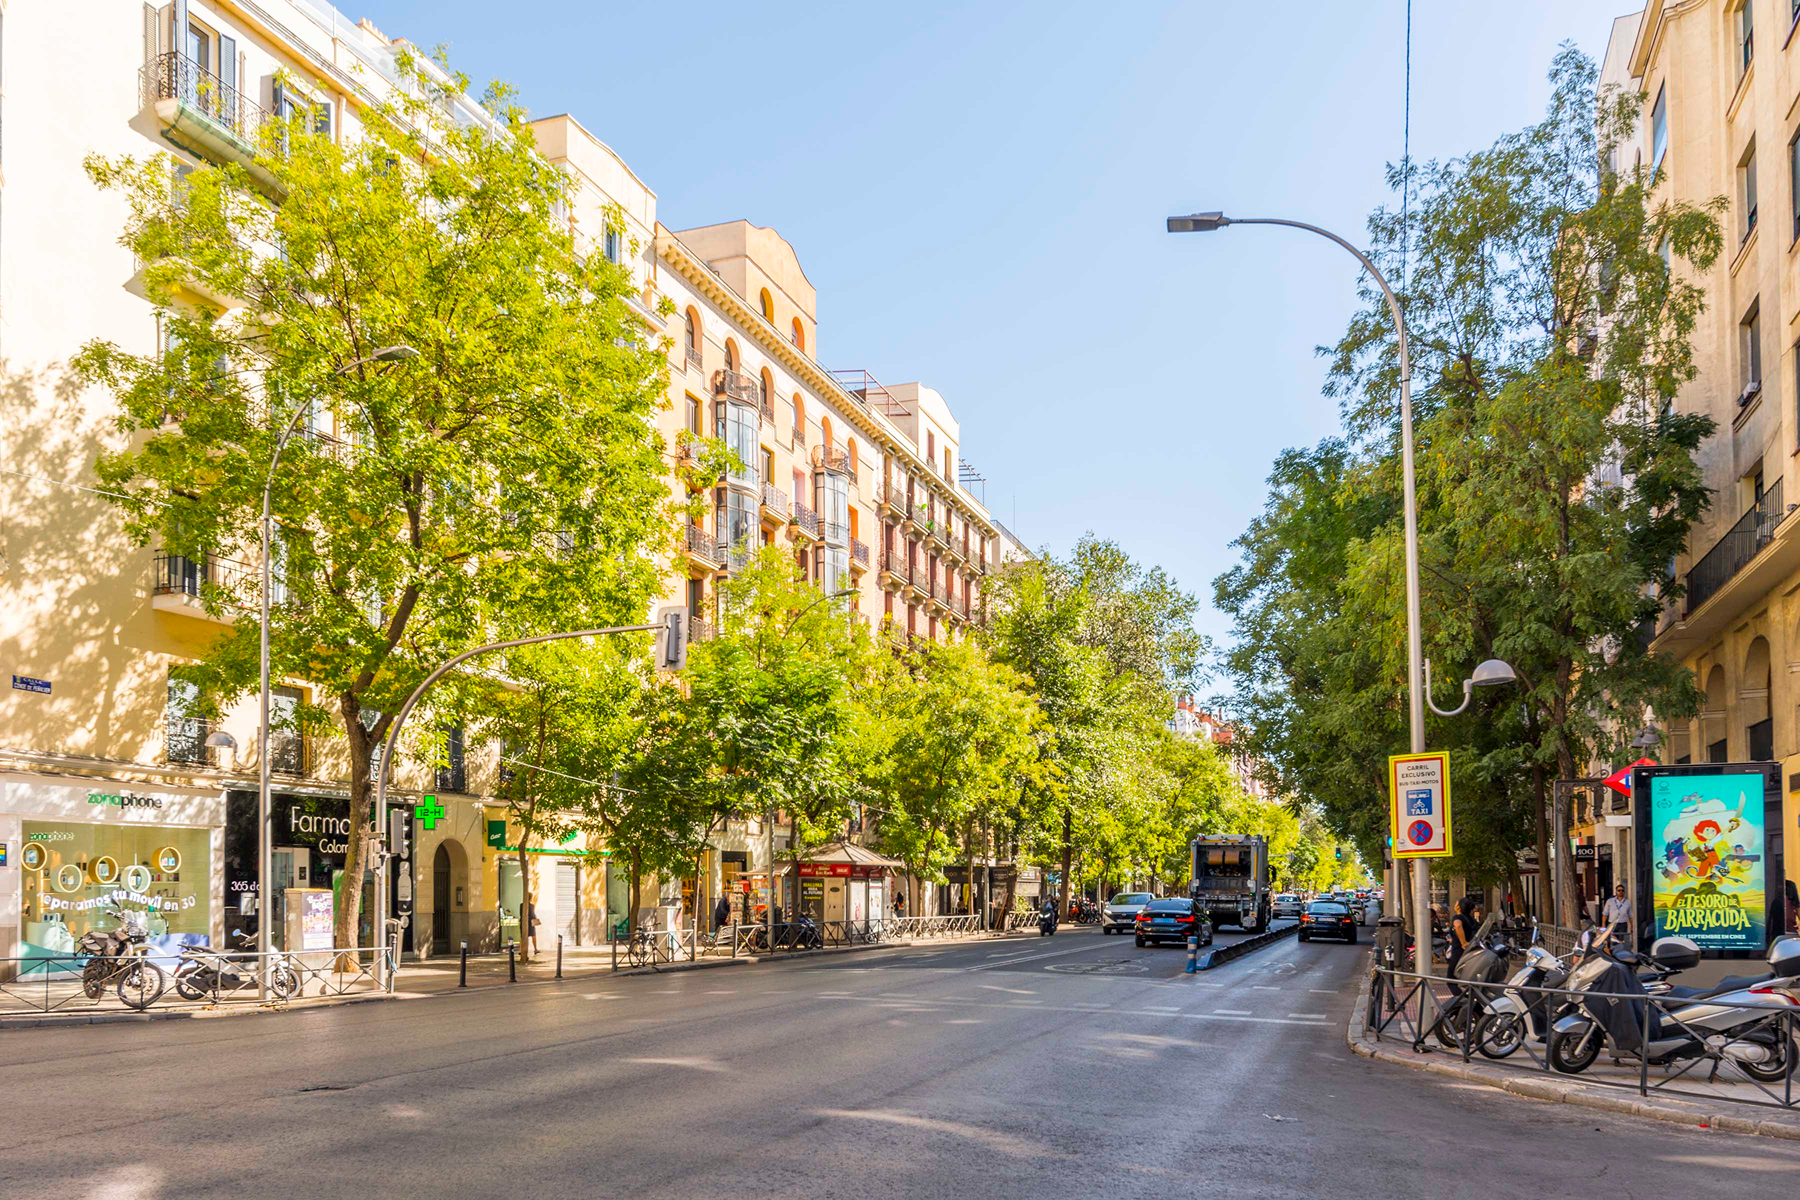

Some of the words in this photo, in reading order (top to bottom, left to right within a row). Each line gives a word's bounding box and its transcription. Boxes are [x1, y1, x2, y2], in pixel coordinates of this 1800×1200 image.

[87, 792, 163, 810] zonaphone
[291, 806, 377, 836] Farma
[30, 831, 75, 843] zonaphone
[1577, 847, 1594, 855] 100
[230, 880, 249, 891] 365
[111, 889, 127, 900] tu
[163, 900, 179, 911] en
[1676, 898, 1687, 908] EL
[1684, 893, 1728, 909] TESORO
[1728, 898, 1738, 906] DE
[1663, 908, 1752, 932] BARRACUDA
